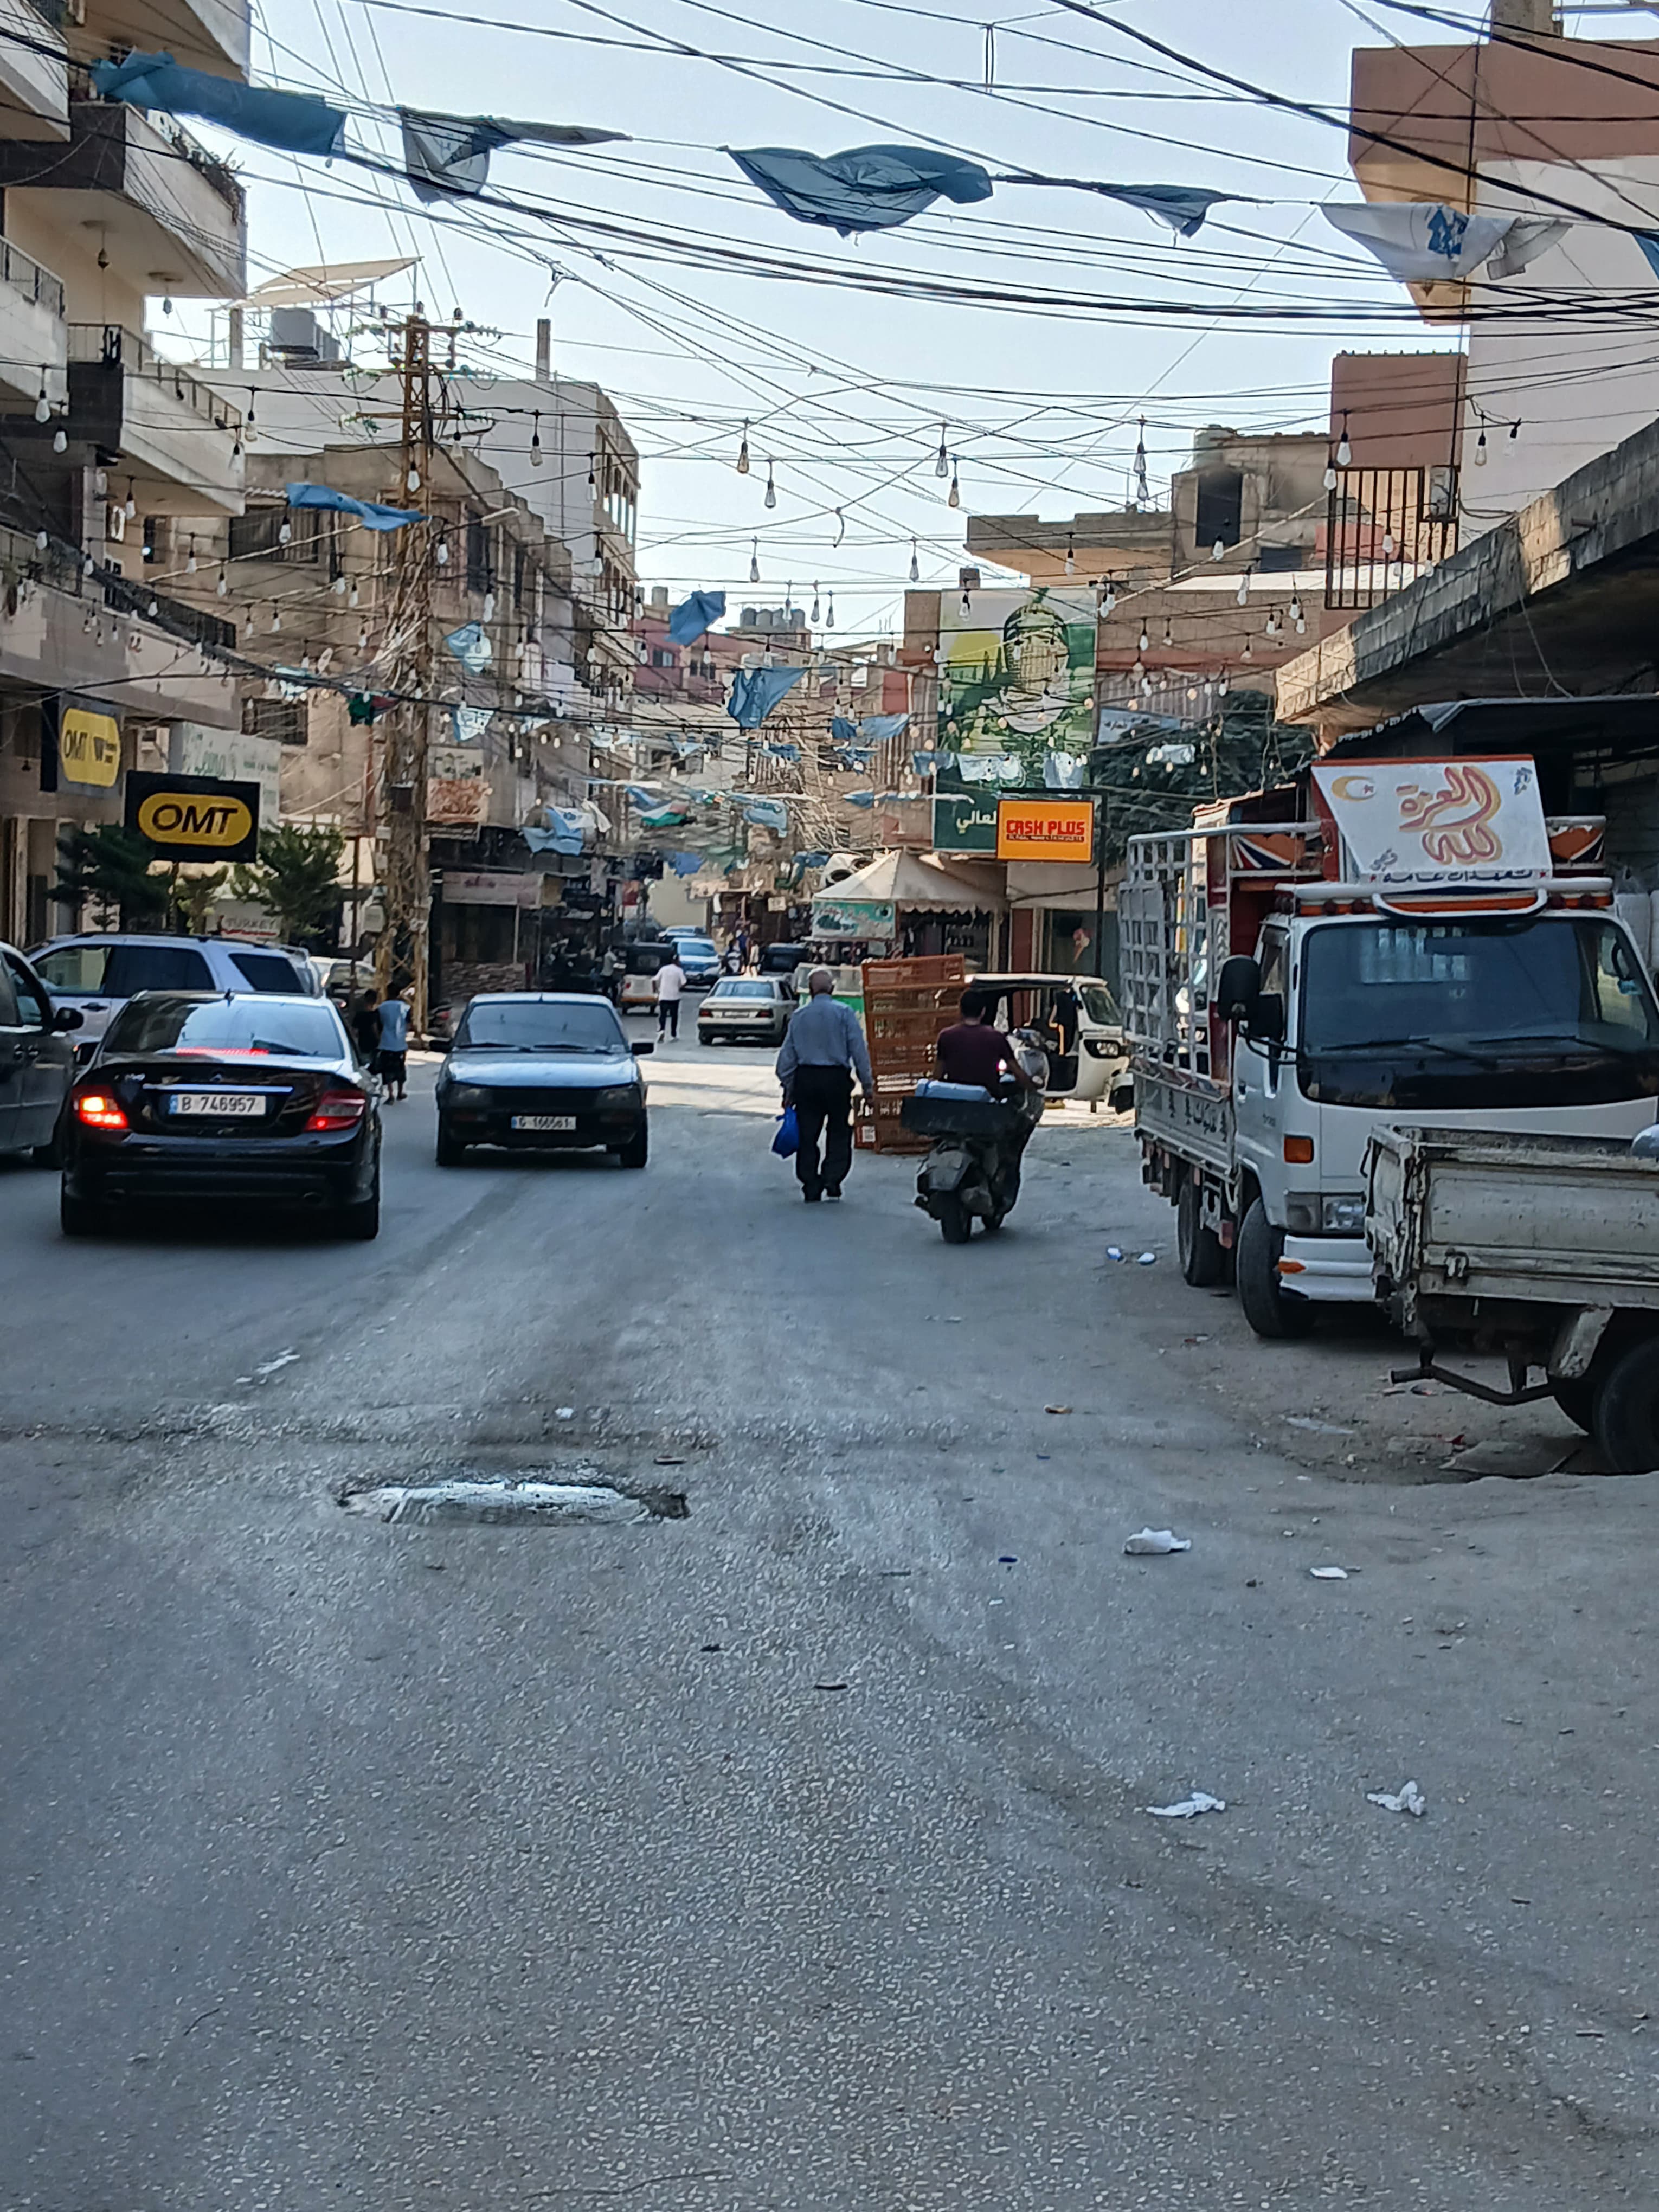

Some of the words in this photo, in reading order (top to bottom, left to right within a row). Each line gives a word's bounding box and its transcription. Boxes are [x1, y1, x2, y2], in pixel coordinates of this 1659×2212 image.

[64, 729, 88, 762] OMT
[152, 803, 239, 834] OMT
[956, 810, 997, 834] لعالي
[1006, 820, 1044, 835] CASH
[1047, 820, 1085, 835] PLUS
[182, 1096, 192, 1112] B
[200, 1096, 256, 1113] 746957
